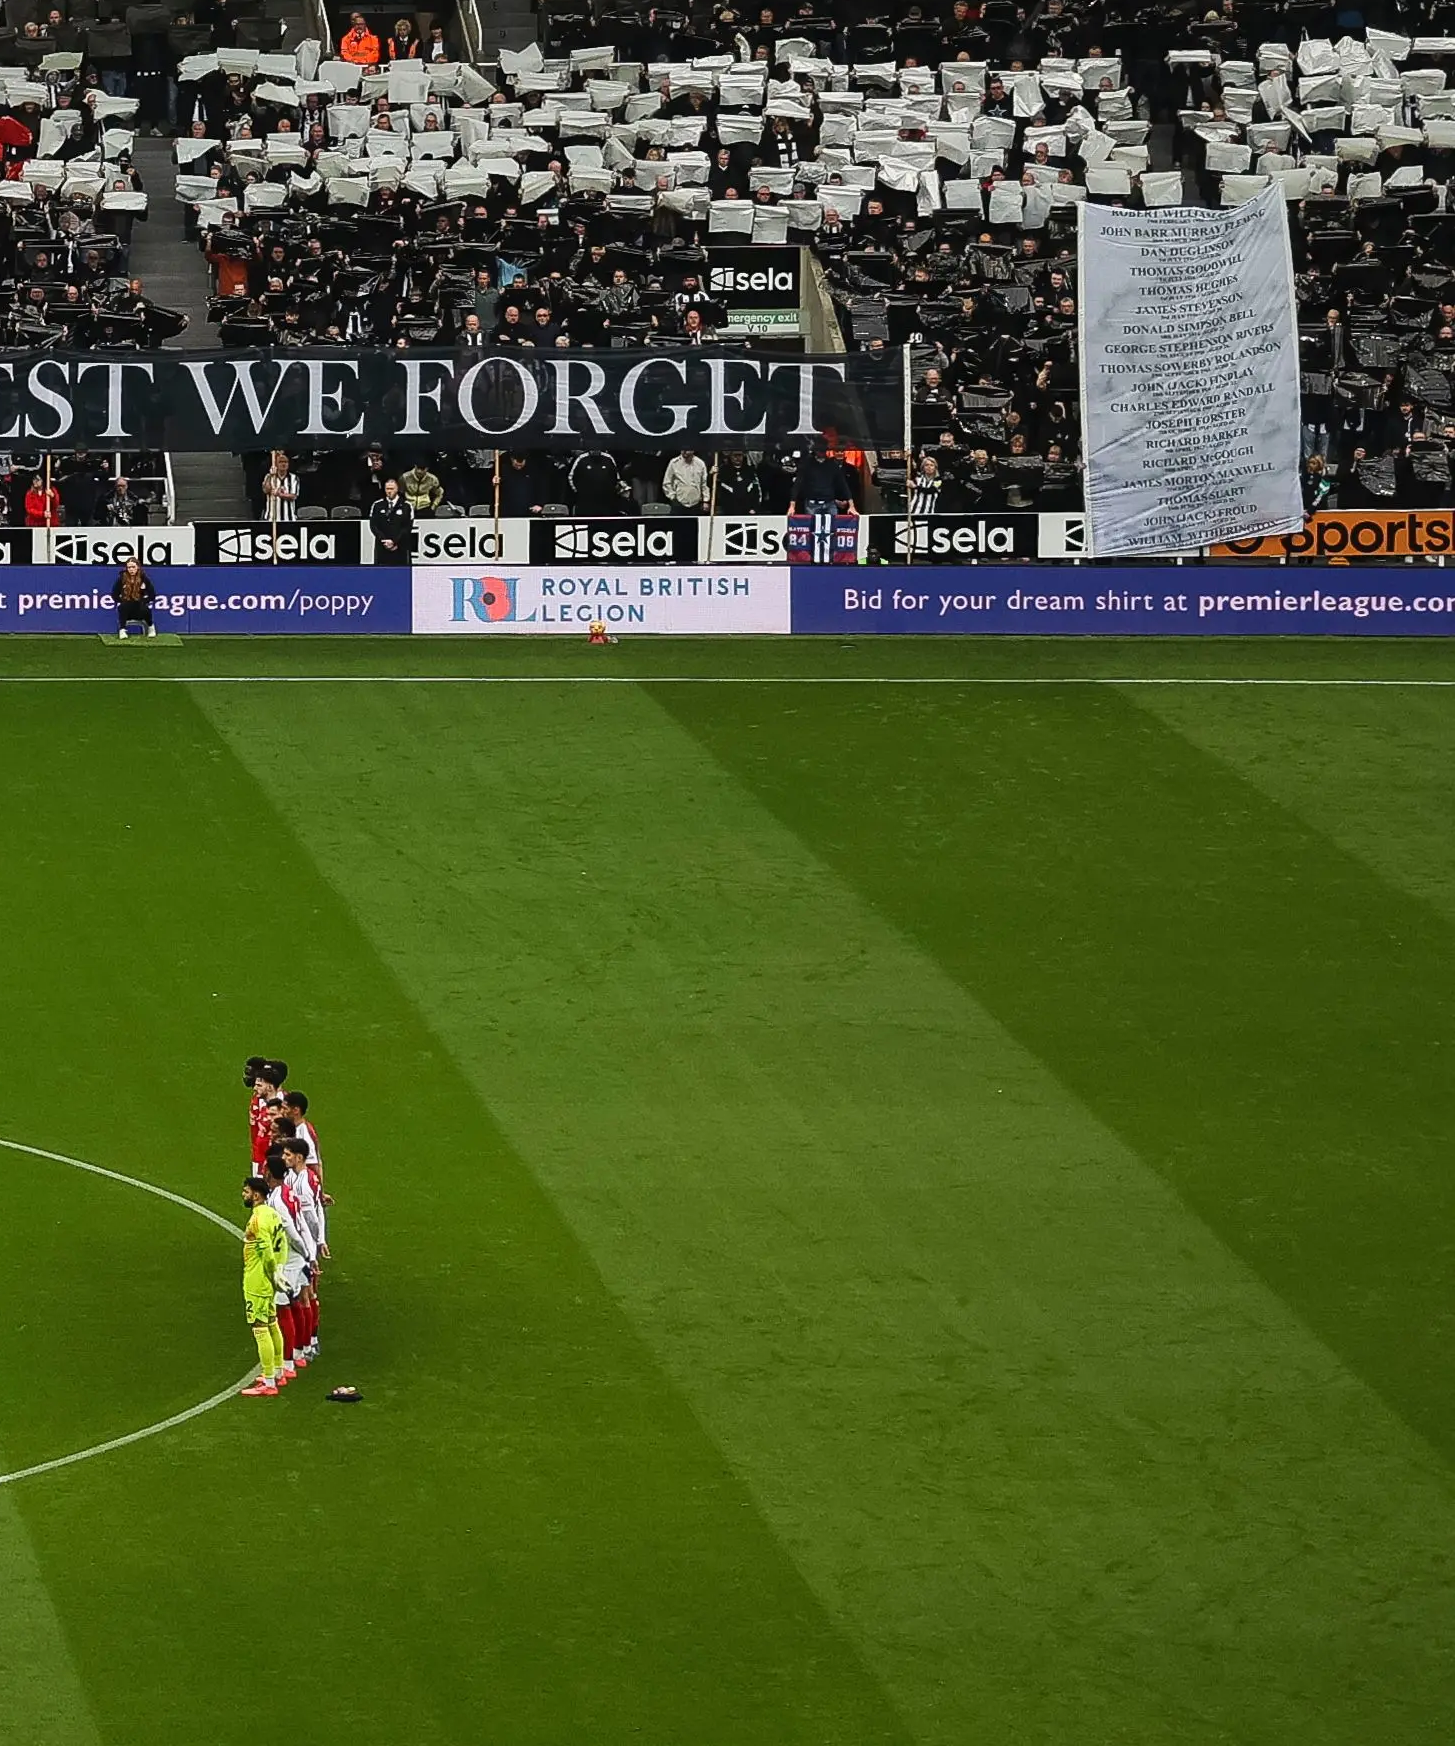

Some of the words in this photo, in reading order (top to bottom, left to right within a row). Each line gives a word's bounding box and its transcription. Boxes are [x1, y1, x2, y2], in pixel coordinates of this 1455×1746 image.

[1100, 226, 1131, 237] JOHN
[1135, 229, 1167, 238] BARR
[1170, 225, 1221, 238] MURRAY
[1141, 247, 1166, 256] DAN
[736, 267, 792, 290] sela
[1130, 266, 1183, 277] THOMAS
[1139, 285, 1192, 296] THOMAS
[1195, 274, 1239, 293] HUGHES
[1134, 303, 1177, 315] JAMES
[1179, 292, 1244, 314] STEVENSON
[778, 313, 797, 322] exit
[1123, 324, 1175, 335] DONALD
[1177, 317, 1227, 334] SIMPSON
[1229, 309, 1257, 323] BELL
[1104, 344, 1157, 355] GEORGE
[1158, 335, 1234, 353] STEPHENSON
[1235, 323, 1275, 340] RIVERS
[1099, 363, 1152, 374] THOMAS
[1153, 357, 1214, 374] SOWERBY
[1215, 341, 1282, 363] ROLANDSON
[1130, 382, 1165, 394] JOHN
[1167, 378, 1208, 391] (JACK)
[1209, 366, 1256, 387] FINDLAY
[180, 358, 366, 439] WE
[394, 356, 846, 436] FORGET
[1110, 402, 1169, 413] CHARLES
[1170, 394, 1222, 410] EDWARD
[1224, 383, 1276, 401] RANDALL
[1145, 418, 1192, 430] JOSEPH
[1195, 407, 1246, 426] FORSTER
[1146, 436, 1200, 450] RICHARD
[1202, 427, 1249, 444] HARKER
[1142, 456, 1196, 469] RICHARD
[1200, 445, 1254, 464] McGOUGH
[1122, 477, 1162, 489] JAMES
[1164, 471, 1215, 486] MORTON
[1217, 462, 1276, 479] MAXWELL
[1157, 493, 1208, 505] THOMAS
[1143, 516, 1176, 527] JOHN
[1217, 504, 1257, 517] FROUD
[256, 527, 335, 559] sela
[419, 526, 503, 559] sela
[592, 524, 674, 557] sela
[932, 520, 1014, 553] sela
[97, 534, 172, 565] sela
[542, 578, 631, 596] ROYAL
[640, 577, 749, 596] BRITISH
[542, 604, 644, 622] LEGION
[844, 589, 882, 610] Bid
[893, 588, 930, 610] for
[939, 593, 996, 615] your
[1007, 589, 1085, 610] dream
[1095, 590, 1154, 611] shirt
[1163, 593, 1188, 611] at
